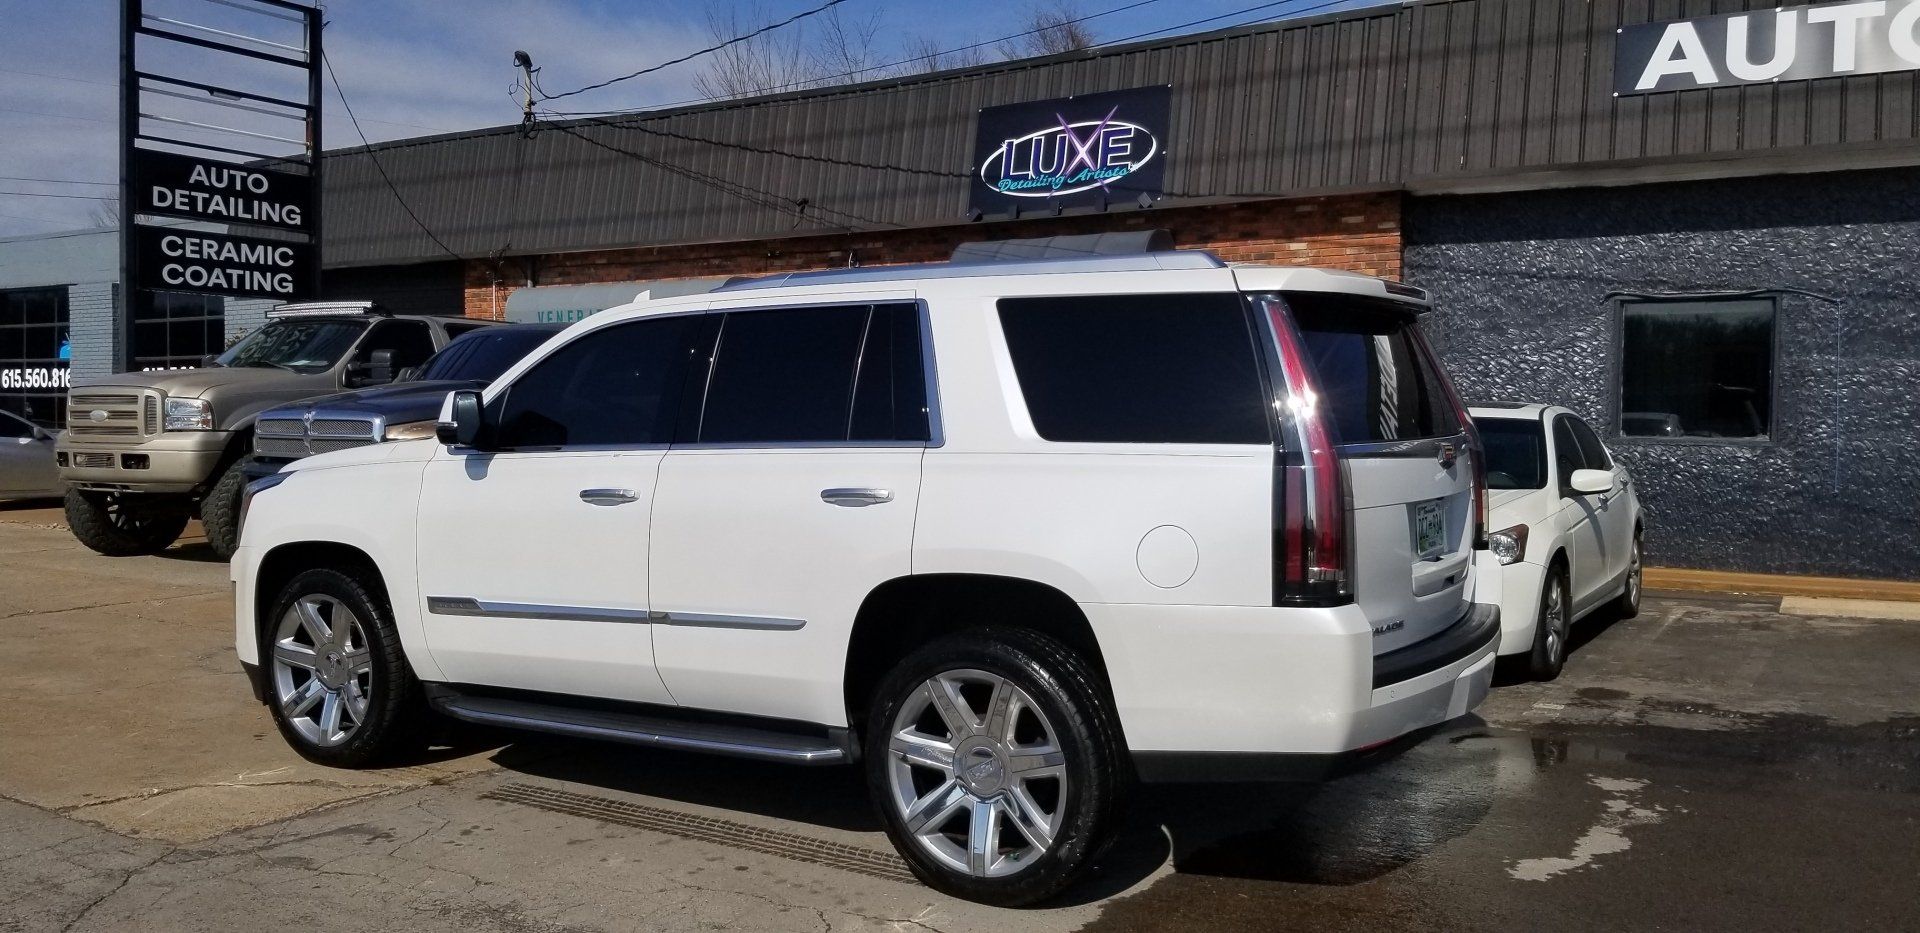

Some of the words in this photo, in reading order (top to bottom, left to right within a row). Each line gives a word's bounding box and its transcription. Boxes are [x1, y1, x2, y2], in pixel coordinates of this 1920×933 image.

[1001, 106, 1134, 190] LUXE
[189, 165, 268, 194] AUTO
[998, 176, 1065, 192] Detailing
[1068, 167, 1129, 183] Artists
[152, 186, 301, 225] DETAILING
[161, 236, 293, 266] CERAMIC
[162, 264, 293, 293] COATING
[537, 309, 603, 323] VENER
[1372, 620, 1404, 634] ALADE
